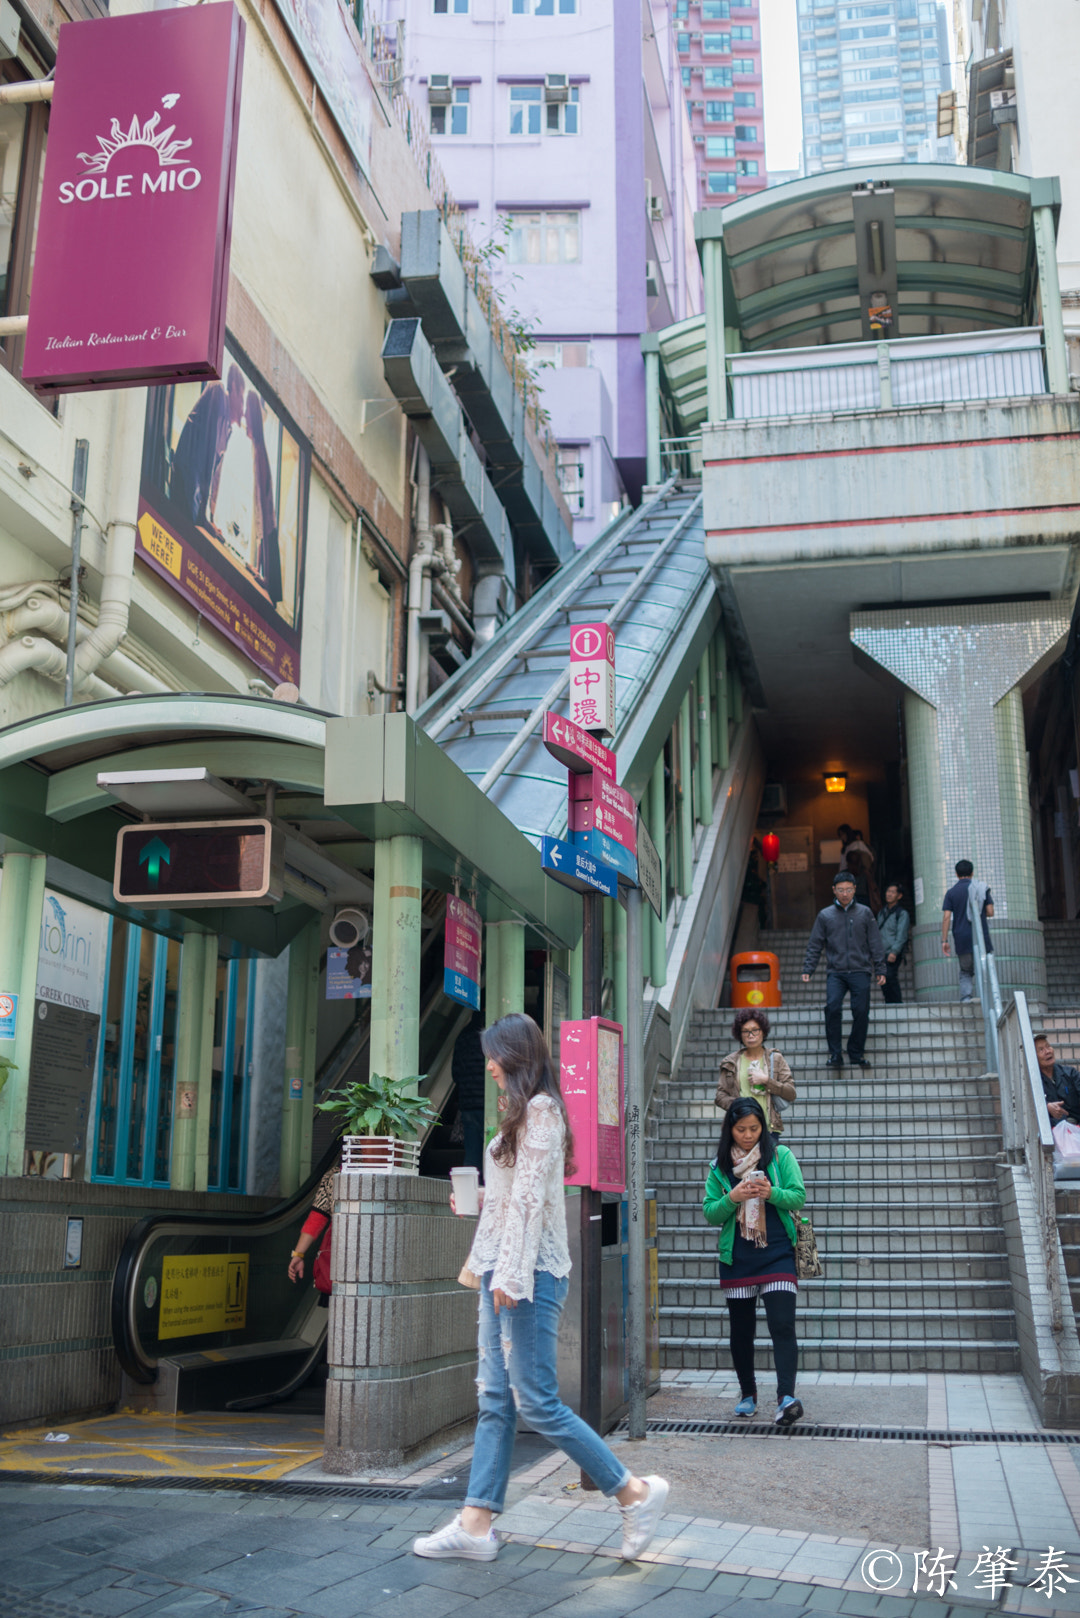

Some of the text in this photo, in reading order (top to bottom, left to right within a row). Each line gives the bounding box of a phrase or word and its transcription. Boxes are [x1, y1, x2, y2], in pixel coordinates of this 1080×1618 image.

[58, 167, 201, 204] SOLE MIO
[45, 325, 187, 350] Italian Restaurant & Bar
[152, 523, 174, 555] WE'RE
[150, 539, 173, 569] HERE!
[573, 667, 601, 725] 中環
[576, 854, 597, 875] 皇后大道中
[575, 868, 611, 894] Queen's Road Central
[40, 985, 62, 1003] GREEK
[63, 992, 90, 1011] CUISINE
